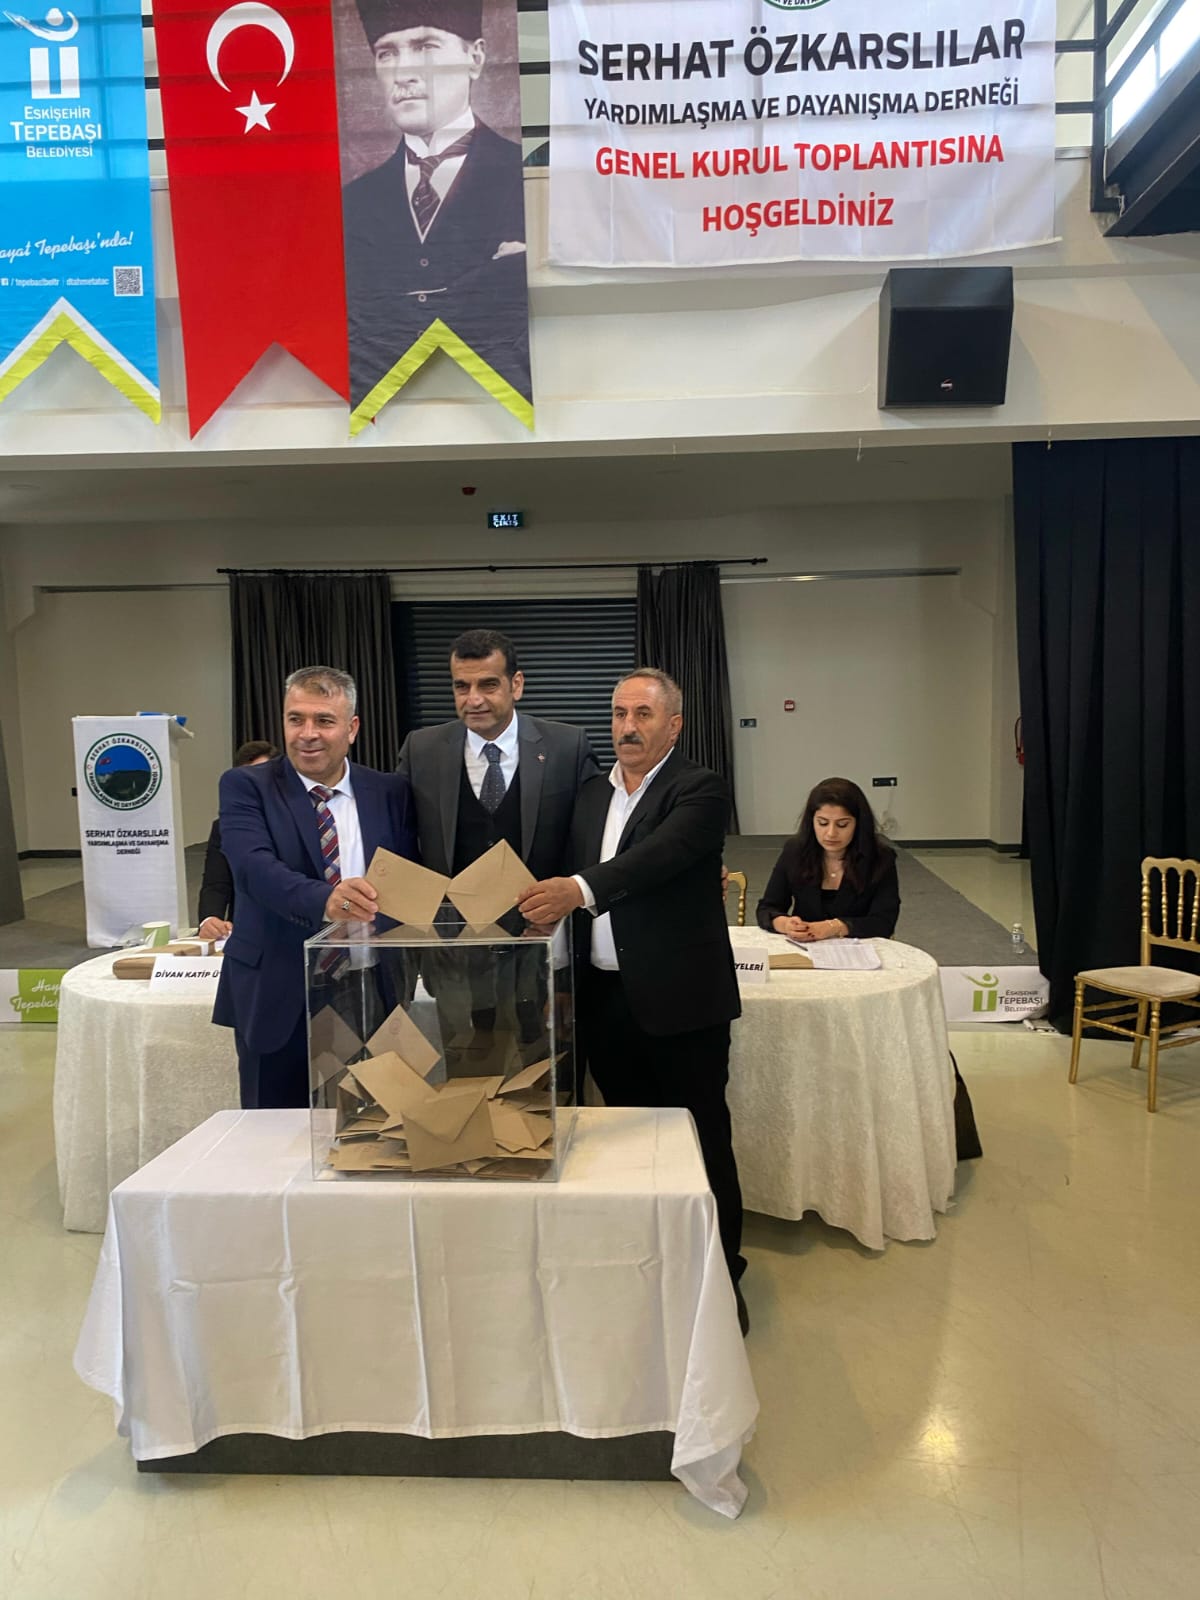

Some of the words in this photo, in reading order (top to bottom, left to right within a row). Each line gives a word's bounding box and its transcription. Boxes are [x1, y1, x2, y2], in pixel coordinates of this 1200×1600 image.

[578, 39, 734, 82] SERHAT
[744, 18, 1025, 76] ÖZKARSLILAR
[24, 105, 91, 122] ESKİŞEHİR
[584, 98, 747, 129] YARDIMLAŞMA
[752, 97, 780, 119] VE
[786, 93, 919, 120] DAYANIŞMA
[924, 77, 1019, 113] DERNEĞİ
[10, 121, 102, 143] TEPEBAŞI
[26, 144, 93, 158] BELEDİYESİ
[595, 146, 685, 179] GENEL
[692, 145, 789, 178] KURUL
[793, 134, 1004, 171] TOPLANTISINA
[702, 191, 894, 237] HOŞGELDİNİZ
[34, 230, 134, 260] Tepebaşı'nda!
[85, 829, 116, 838] SERHAT
[116, 828, 169, 838] ÖZKARSLILAR
[154, 969, 184, 978] DİVAN
[184, 969, 211, 978] KATİP
[998, 996, 1043, 1006] TEPEBAŞI
